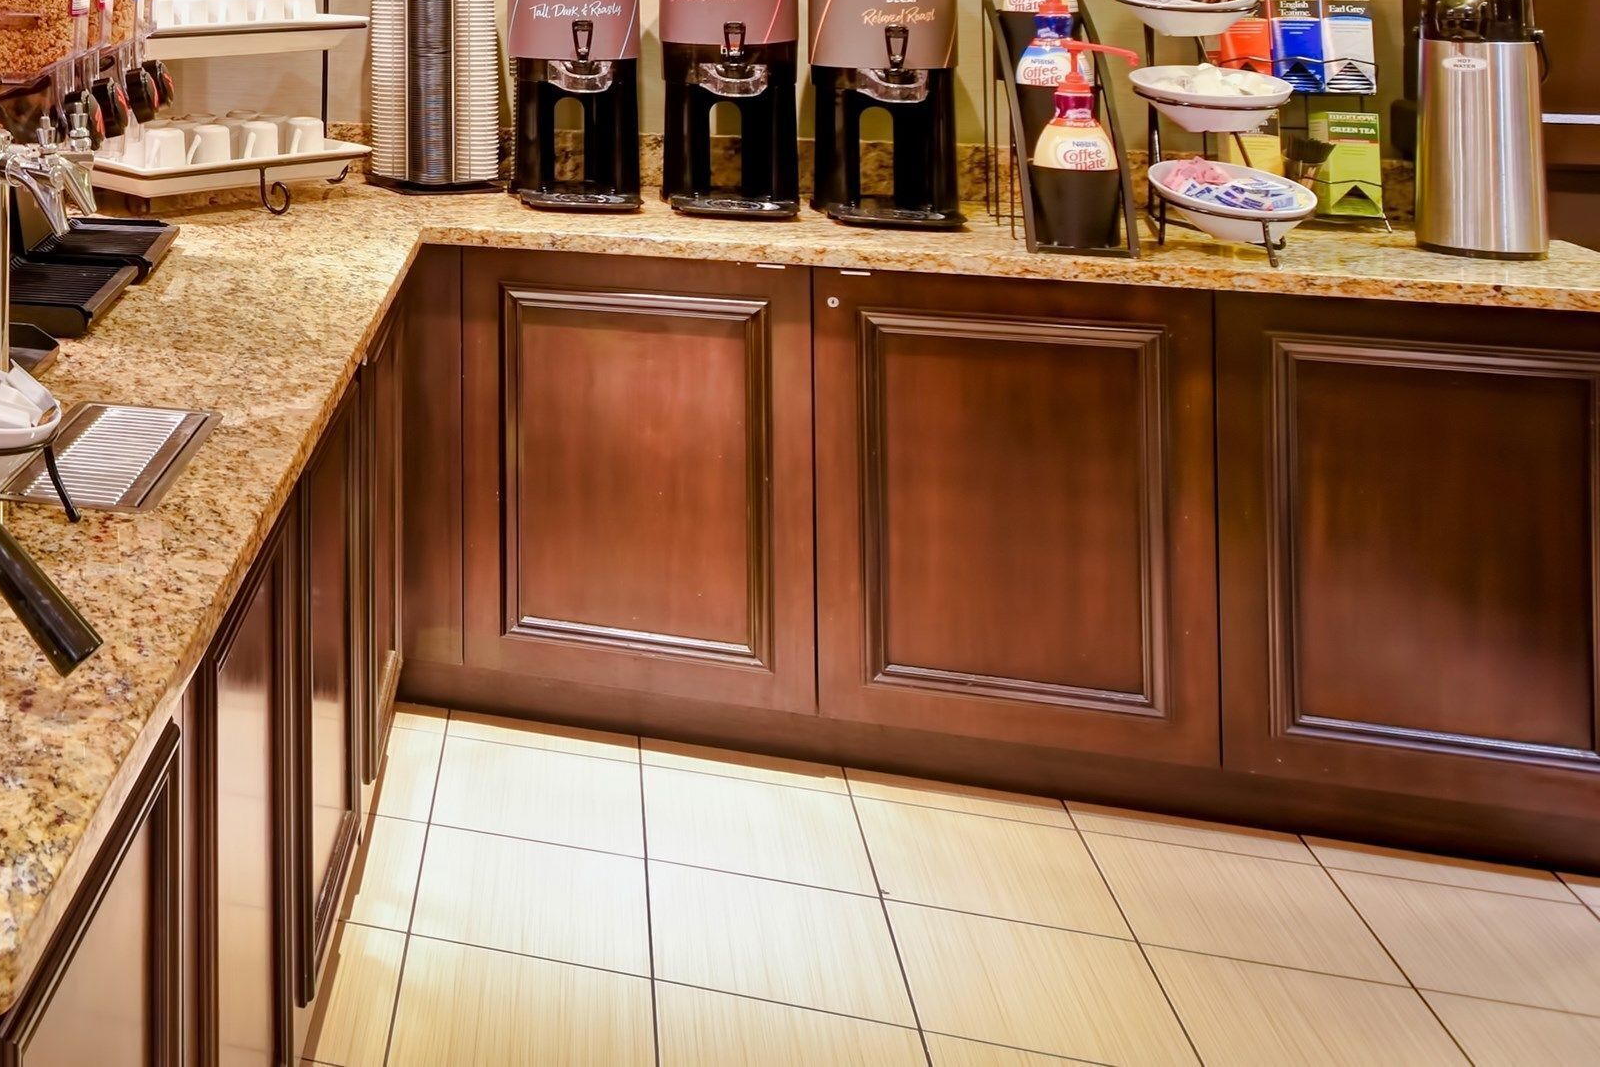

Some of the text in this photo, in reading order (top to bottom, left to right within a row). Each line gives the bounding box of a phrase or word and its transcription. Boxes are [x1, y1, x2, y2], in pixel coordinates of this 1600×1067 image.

[1280, 1, 1309, 10] English
[1329, 5, 1366, 16] Earl Grey
[906, 6, 936, 25] Roast
[1023, 65, 1059, 81] Coffee
[1359, 127, 1376, 135] TEA
[1063, 149, 1102, 165] Coffee
